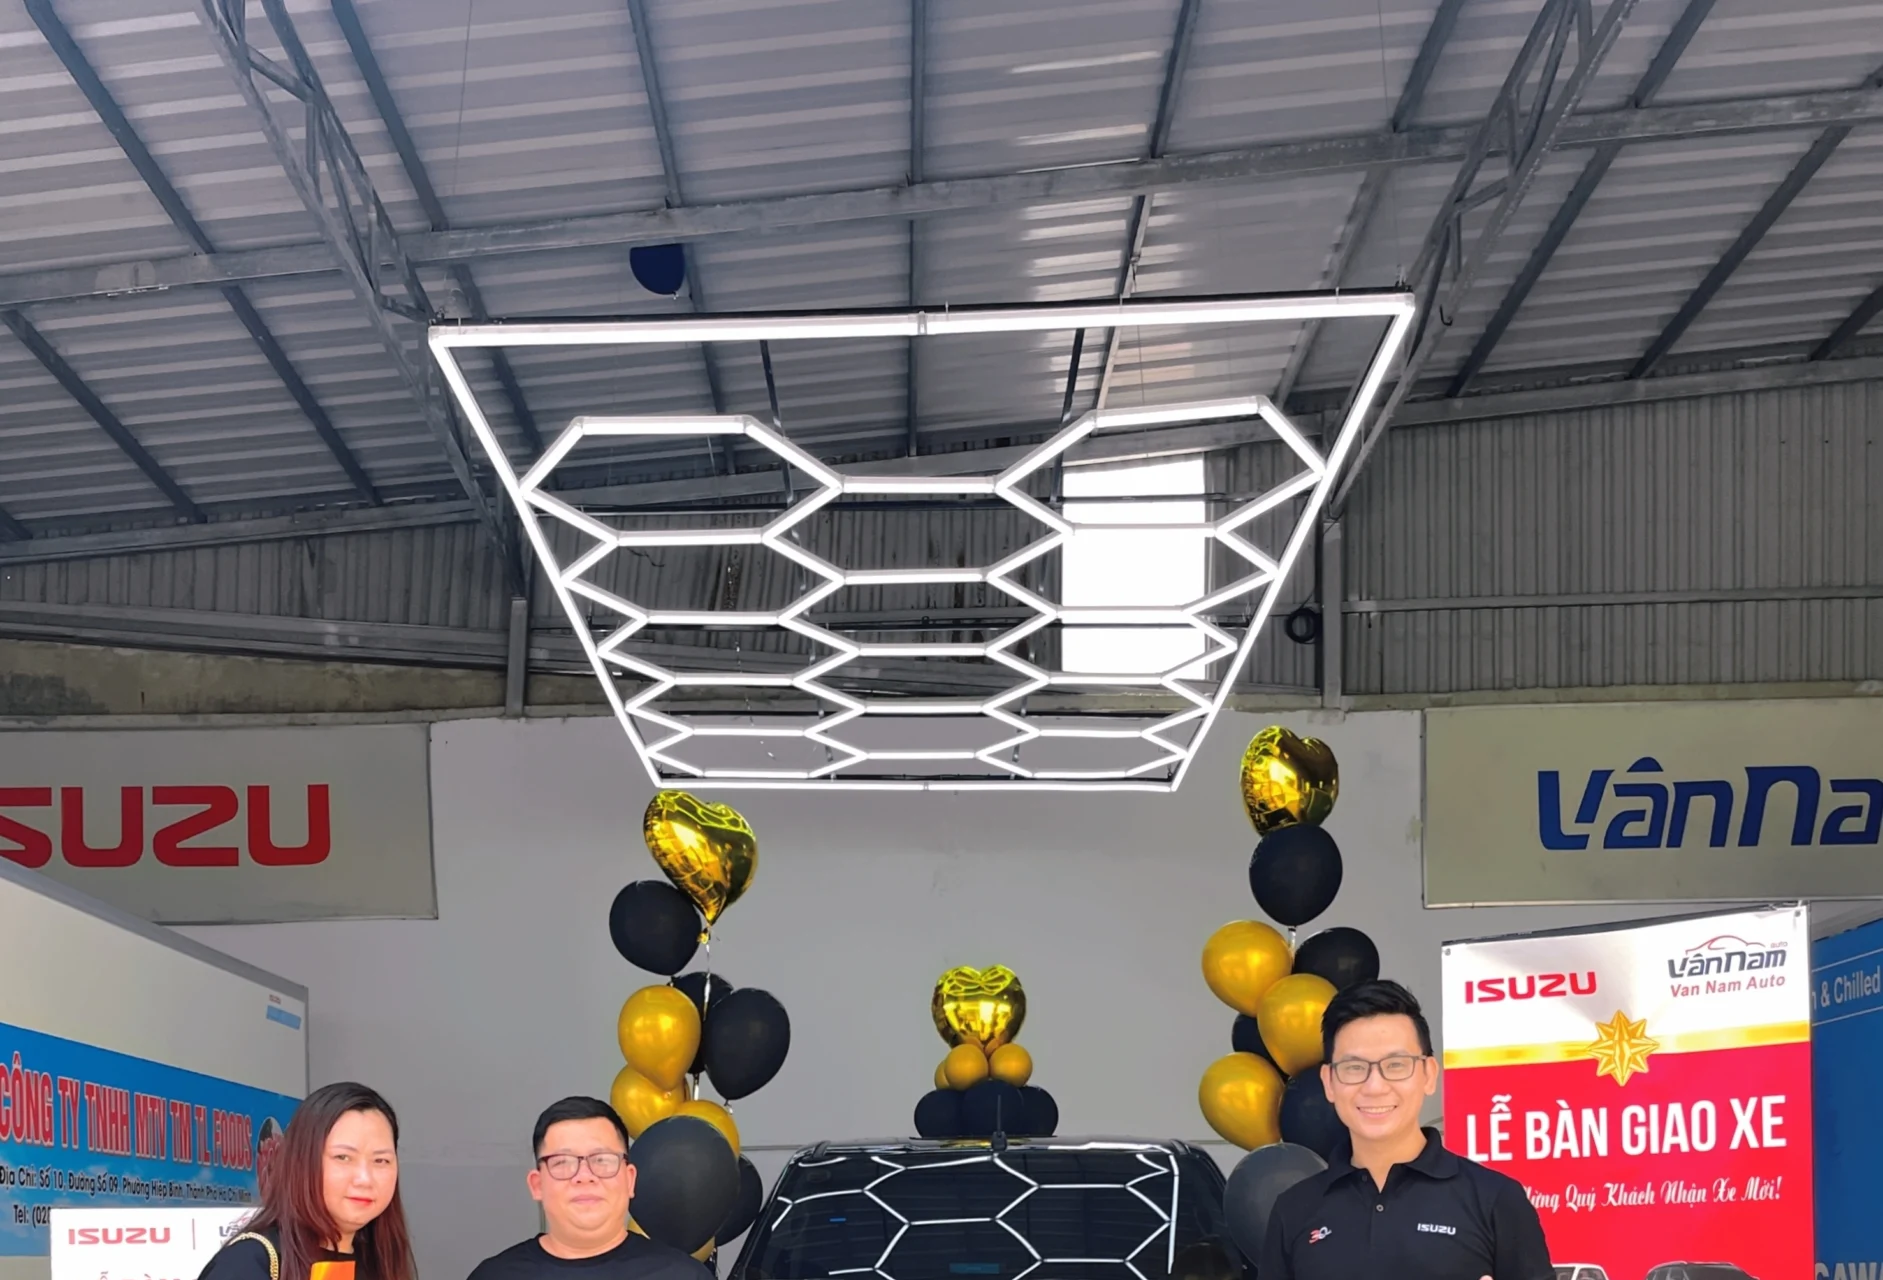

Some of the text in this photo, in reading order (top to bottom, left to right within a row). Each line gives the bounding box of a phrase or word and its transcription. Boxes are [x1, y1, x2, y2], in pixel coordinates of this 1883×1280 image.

[1465, 972, 1597, 1003] ISUZU
[1670, 974, 1786, 998] Van Nam Auto
[1834, 964, 1881, 1004] Chilled
[0, 1050, 54, 1147] CÔNG
[57, 1075, 80, 1150] TY
[84, 1081, 131, 1156] TNHH
[134, 1091, 167, 1161] MTV
[170, 1099, 192, 1163] TM
[213, 1108, 253, 1172] FOODS
[1465, 1094, 1787, 1162] LỄ BÀN GIAO XE
[1565, 1183, 1596, 1213] Quý
[1601, 1181, 1656, 1207] Khách
[13, 1204, 30, 1224] Tel:
[1417, 1222, 1456, 1236] ISUZU
[68, 1227, 171, 1245] ISUZU
